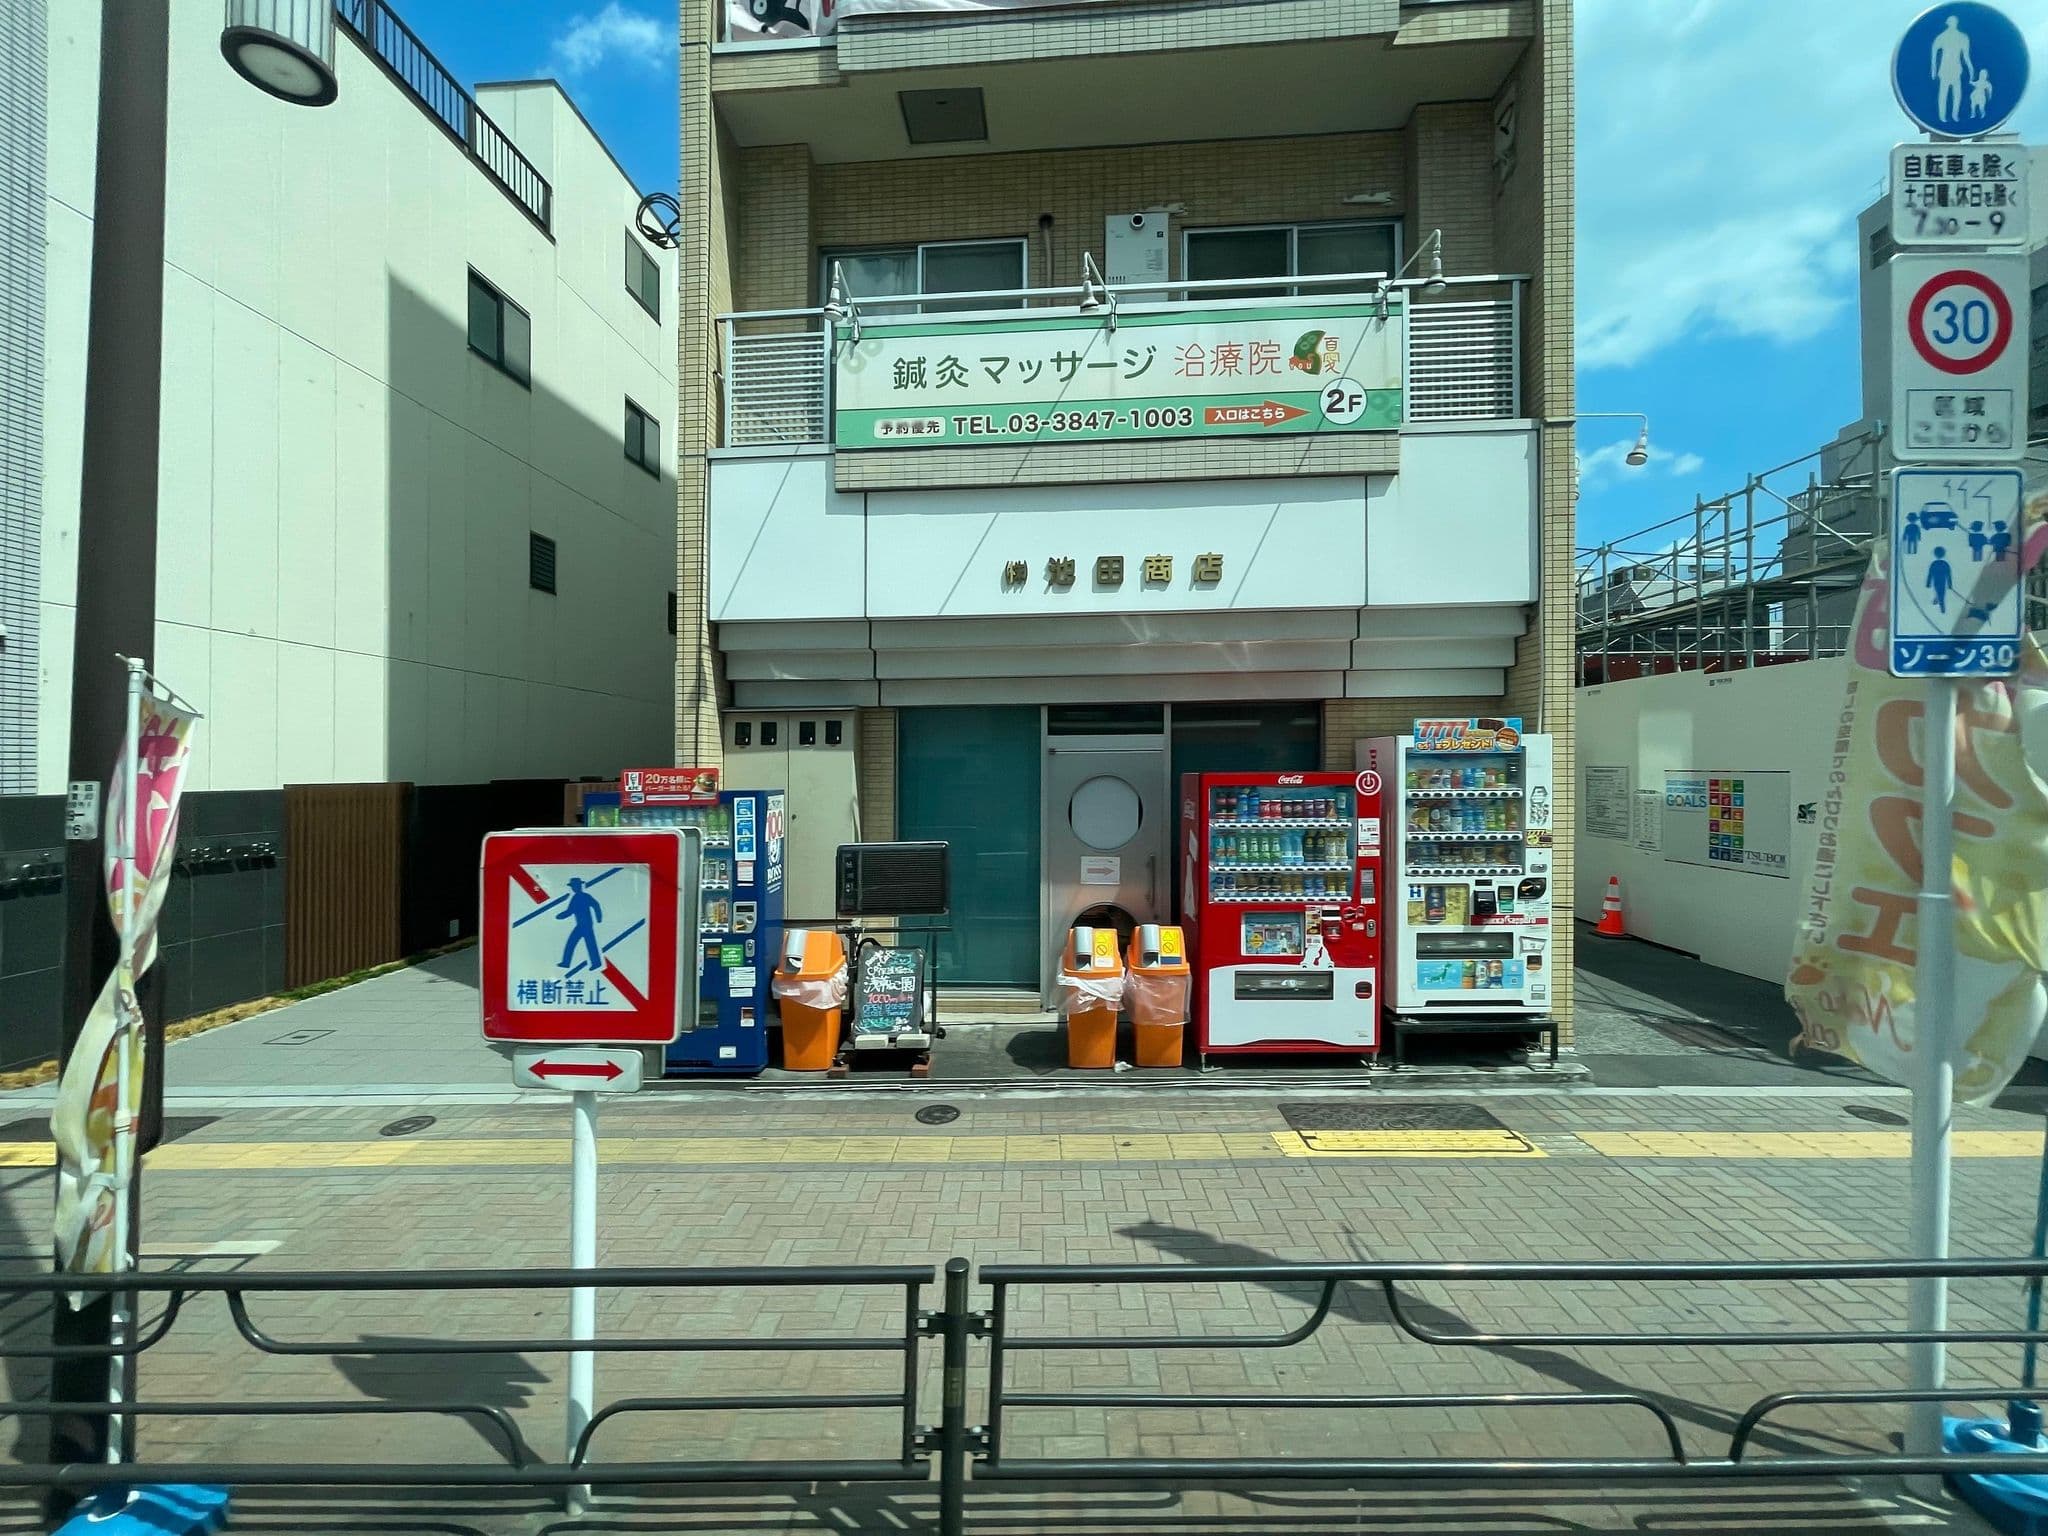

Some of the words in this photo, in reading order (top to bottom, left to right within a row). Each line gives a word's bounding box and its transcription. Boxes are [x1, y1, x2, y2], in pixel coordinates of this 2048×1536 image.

[1904, 153, 2016, 178] 自転車を除く
[1932, 300, 1990, 345] 30
[893, 345, 1157, 390] 鍼灸マッサージ
[1174, 339, 1282, 377] 治療院
[1326, 389, 1363, 414] 2F
[953, 407, 1193, 436] TEL.03-3847-1003
[1213, 407, 1286, 422] 入口はこちら
[1666, 794, 1707, 808] GOALS
[516, 979, 610, 1005] 横断禁止
